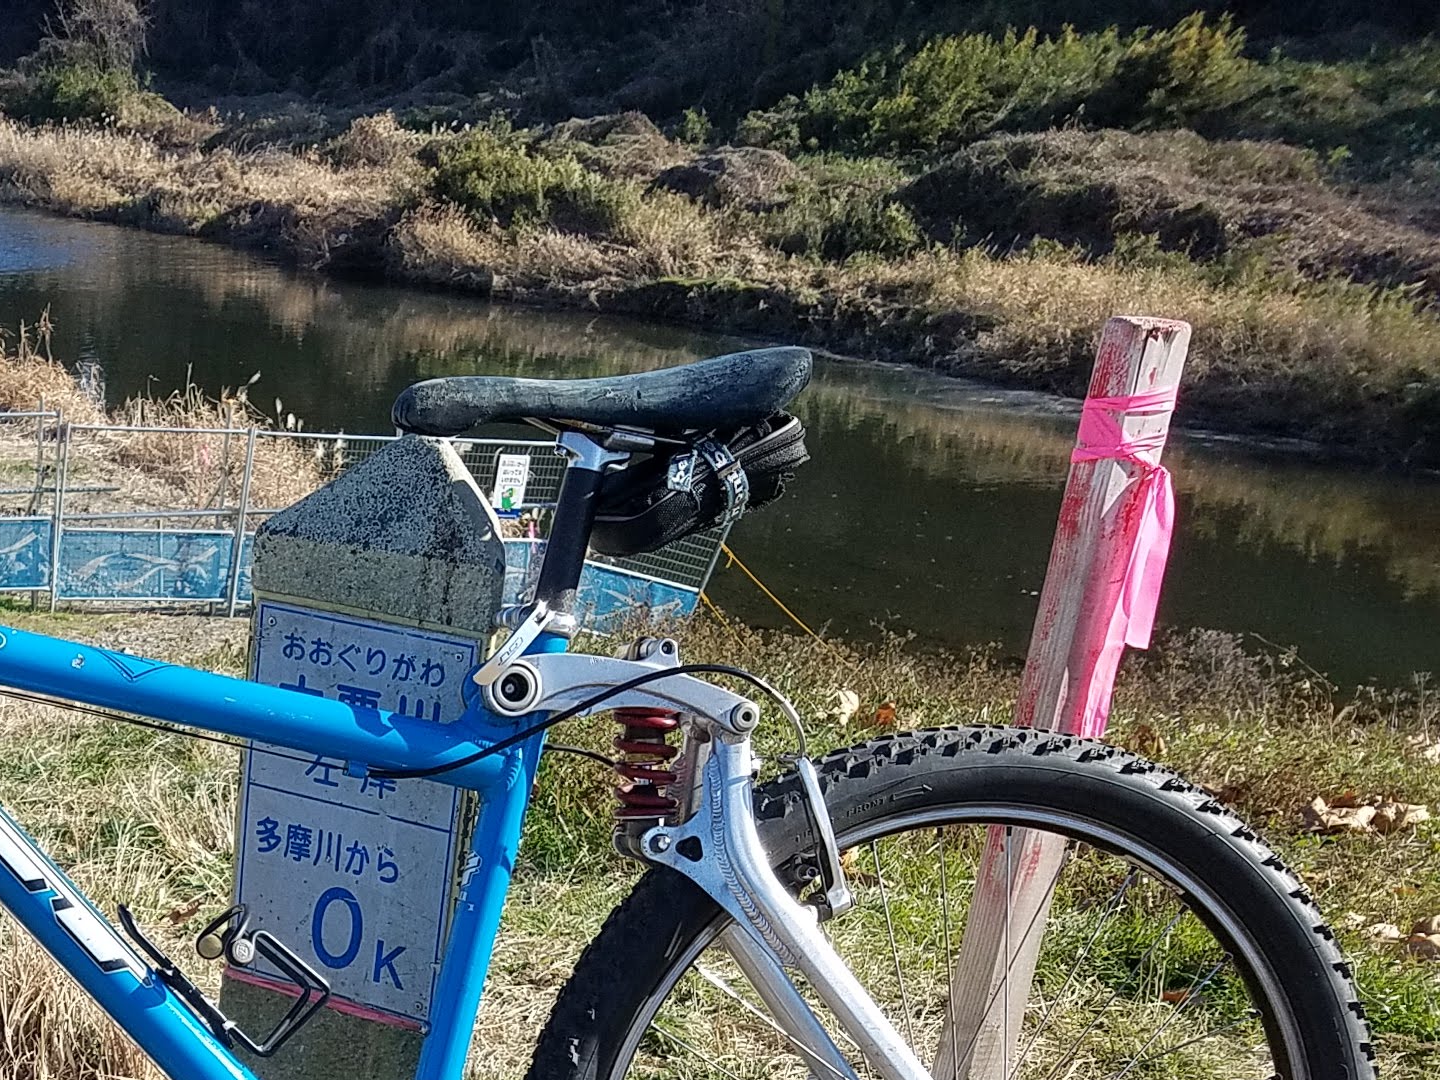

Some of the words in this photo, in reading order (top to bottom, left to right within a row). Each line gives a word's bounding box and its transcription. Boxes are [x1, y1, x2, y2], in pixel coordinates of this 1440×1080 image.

[282, 632, 446, 689] おおぐりがわ
[256, 816, 399, 884] 多摩川から
